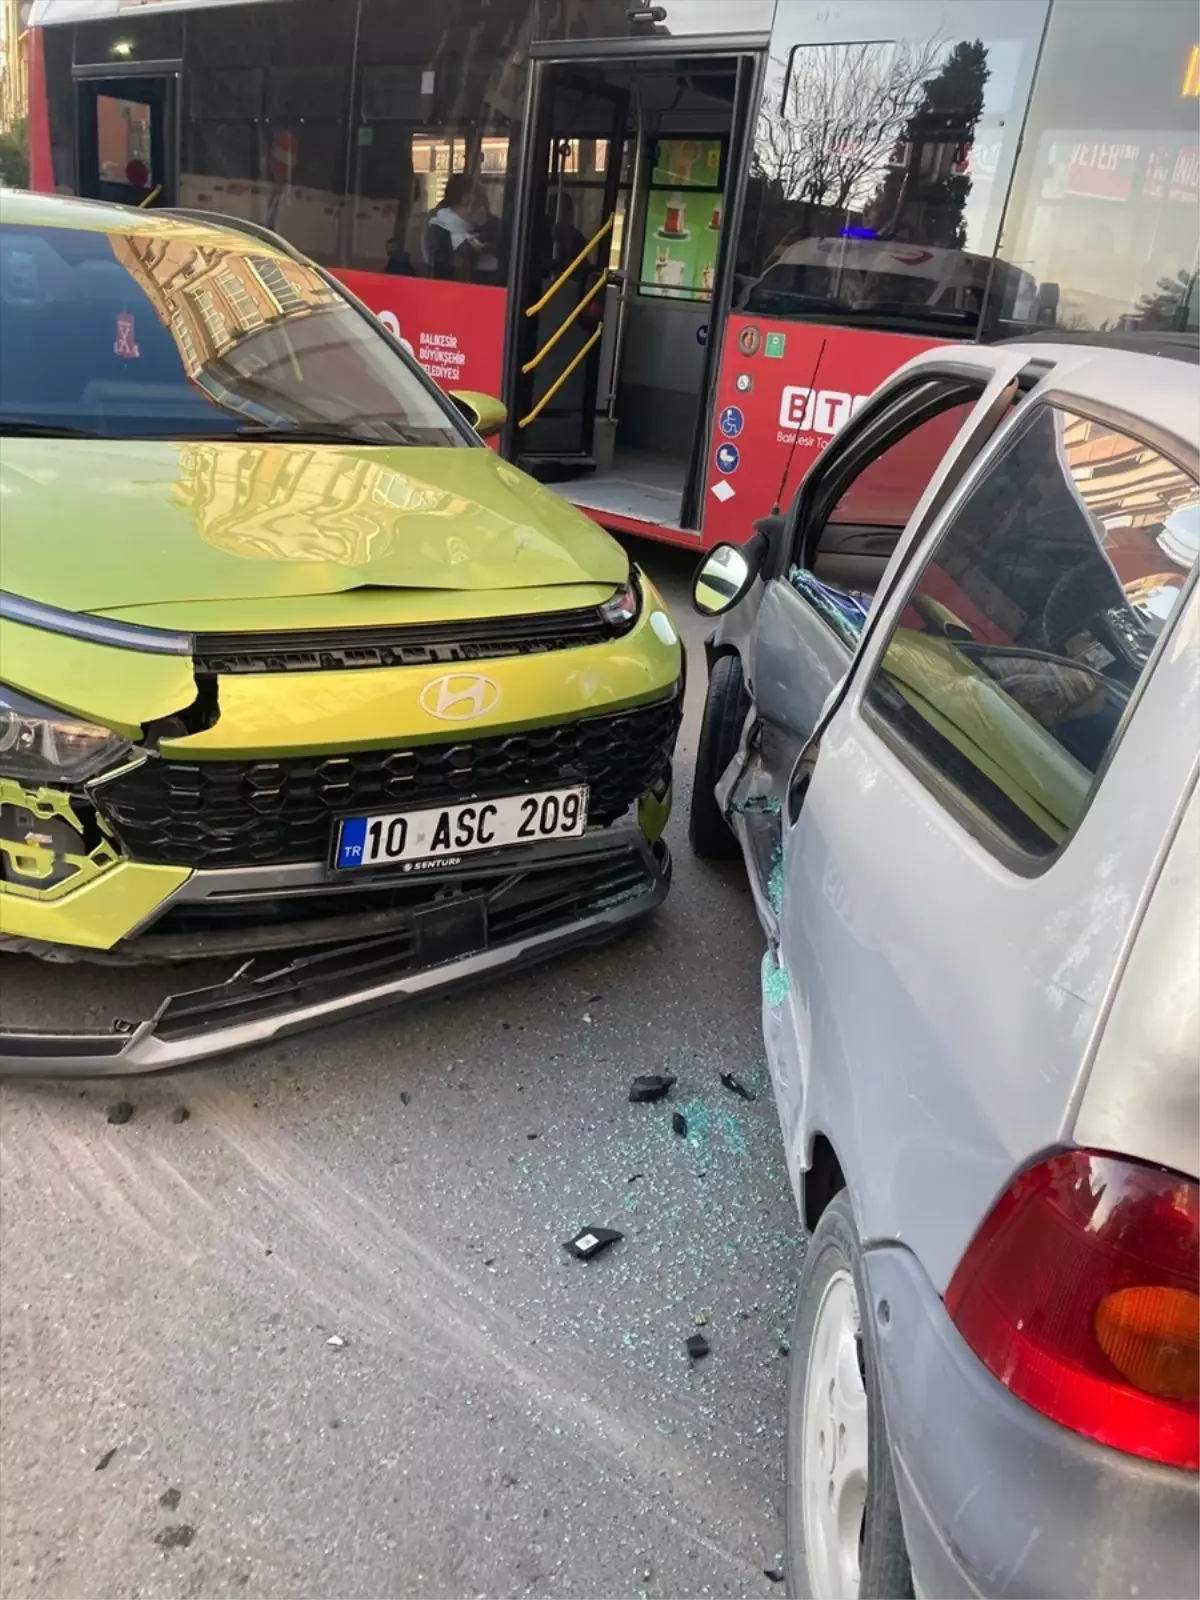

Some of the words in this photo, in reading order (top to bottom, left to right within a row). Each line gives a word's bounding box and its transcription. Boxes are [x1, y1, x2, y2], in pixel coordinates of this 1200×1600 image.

[420, 332, 457, 348] BALIKESİR
[420, 346, 465, 365] BÜYÜKŞEHİR
[423, 364, 459, 380] ELEDİYESİ
[781, 387, 858, 433] BT
[369, 817, 408, 860] 10
[430, 804, 498, 851] ASC
[517, 793, 581, 838] 209
[344, 845, 361, 857] TR
